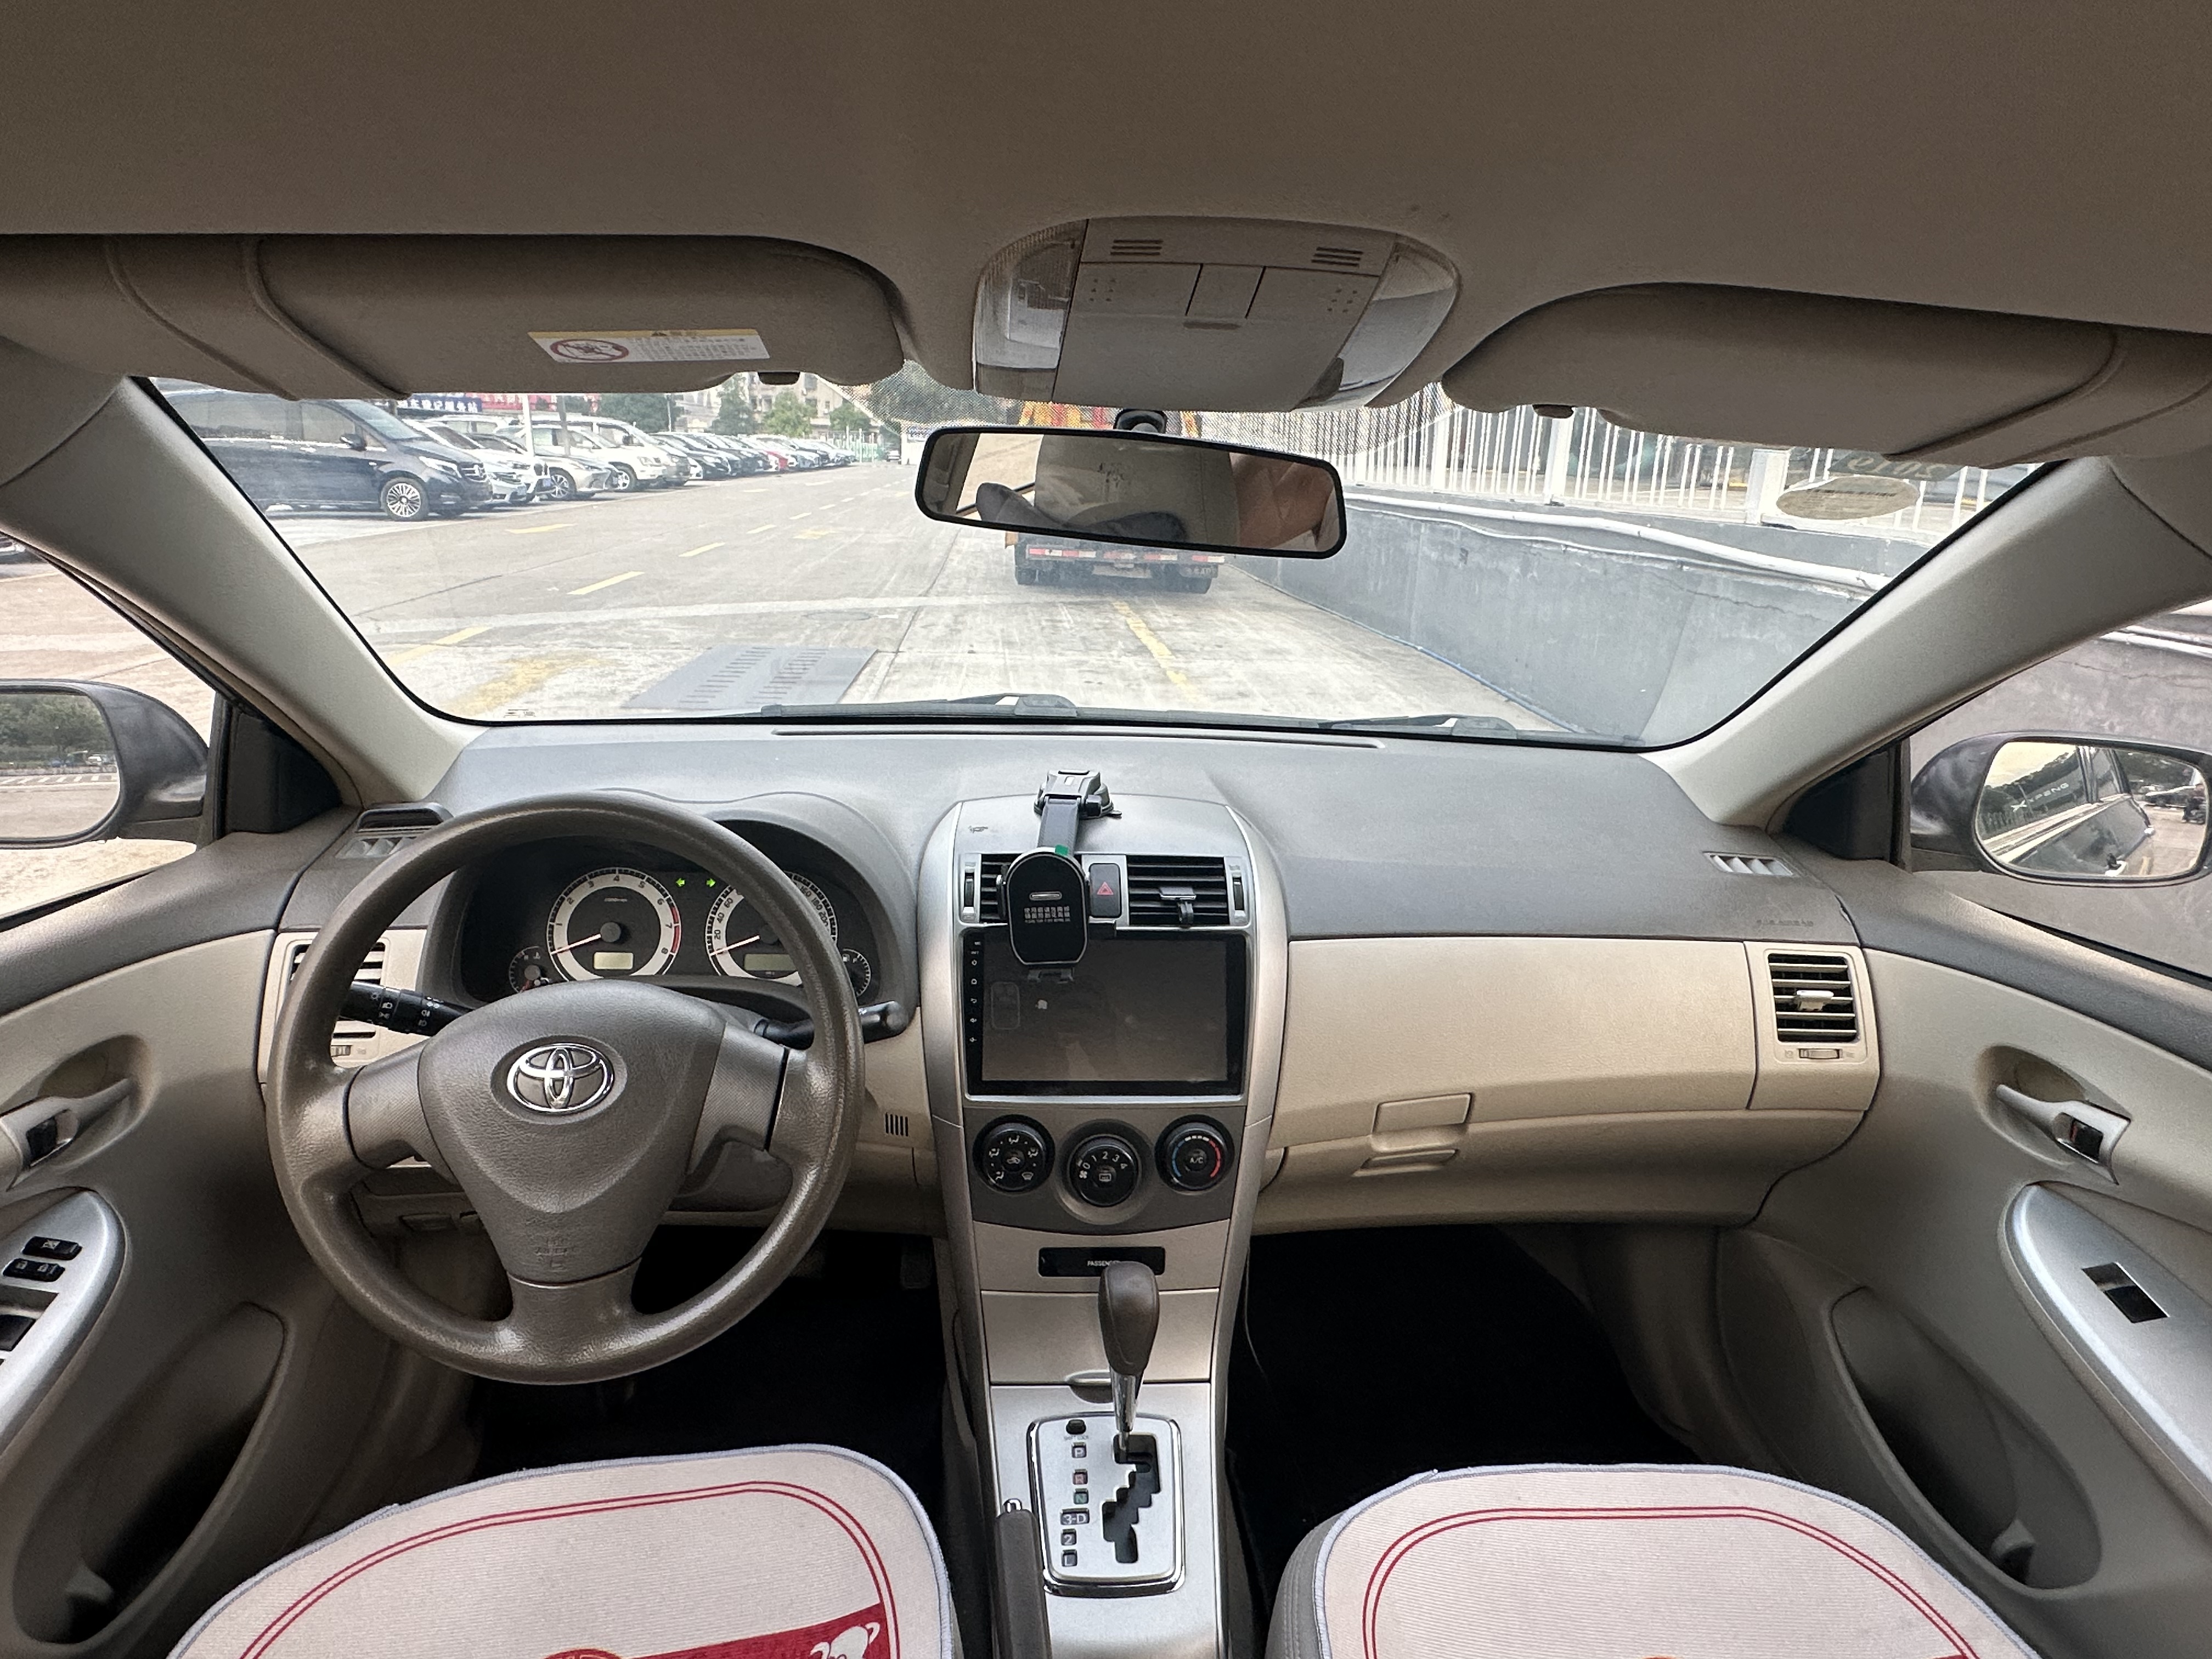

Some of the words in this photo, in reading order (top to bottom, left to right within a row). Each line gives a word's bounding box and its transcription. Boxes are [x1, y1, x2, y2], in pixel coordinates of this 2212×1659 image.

[723, 897, 733, 909] 60
[811, 897, 823, 911] 180
[716, 912, 725, 924] 40
[714, 929, 721, 940] 20
[1102, 1151, 1108, 1160] 2
[1112, 1154, 1120, 1162] 3
[1074, 1447, 1085, 1458] P
[1075, 1474, 1085, 1484] R
[1076, 1493, 1087, 1504] N
[1063, 1513, 1086, 1525] 3-D
[1063, 1534, 1073, 1545] 2
[1064, 1555, 1074, 1566] L
